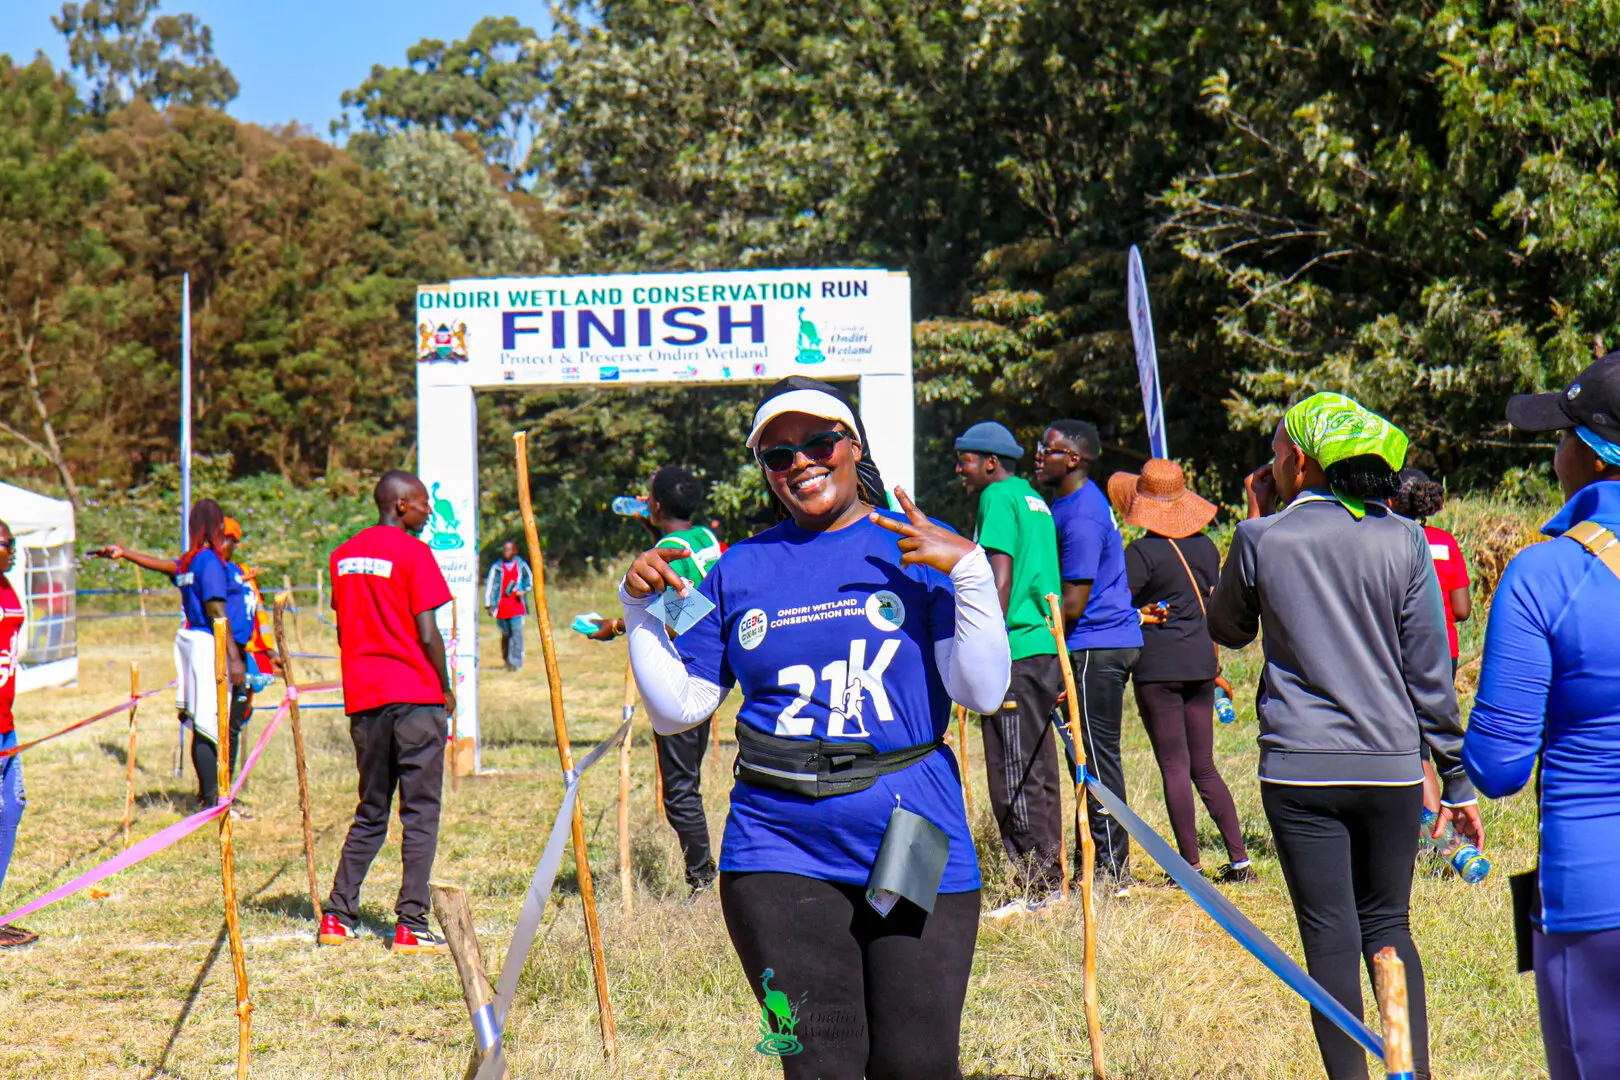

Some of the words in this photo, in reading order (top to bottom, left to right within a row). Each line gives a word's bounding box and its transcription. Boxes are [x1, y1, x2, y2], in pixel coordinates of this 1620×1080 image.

[419, 291, 499, 309] ONDIRI
[508, 288, 622, 307] WETLAND
[633, 282, 811, 304] CONSERVATION
[822, 280, 867, 298] RUN
[502, 304, 765, 350] FINISH
[831, 332, 867, 343] Ondiri
[500, 352, 552, 365] Protect
[560, 353, 573, 364] &
[580, 351, 642, 363] Preserve
[649, 349, 699, 361] Ondiri
[705, 346, 768, 359] Wetland
[770, 610, 842, 628] CONSERVATION
[844, 606, 865, 617] RUN
[777, 606, 810, 617] ONDIRI
[813, 598, 857, 612] WETLAND
[775, 638, 901, 737] 21K
